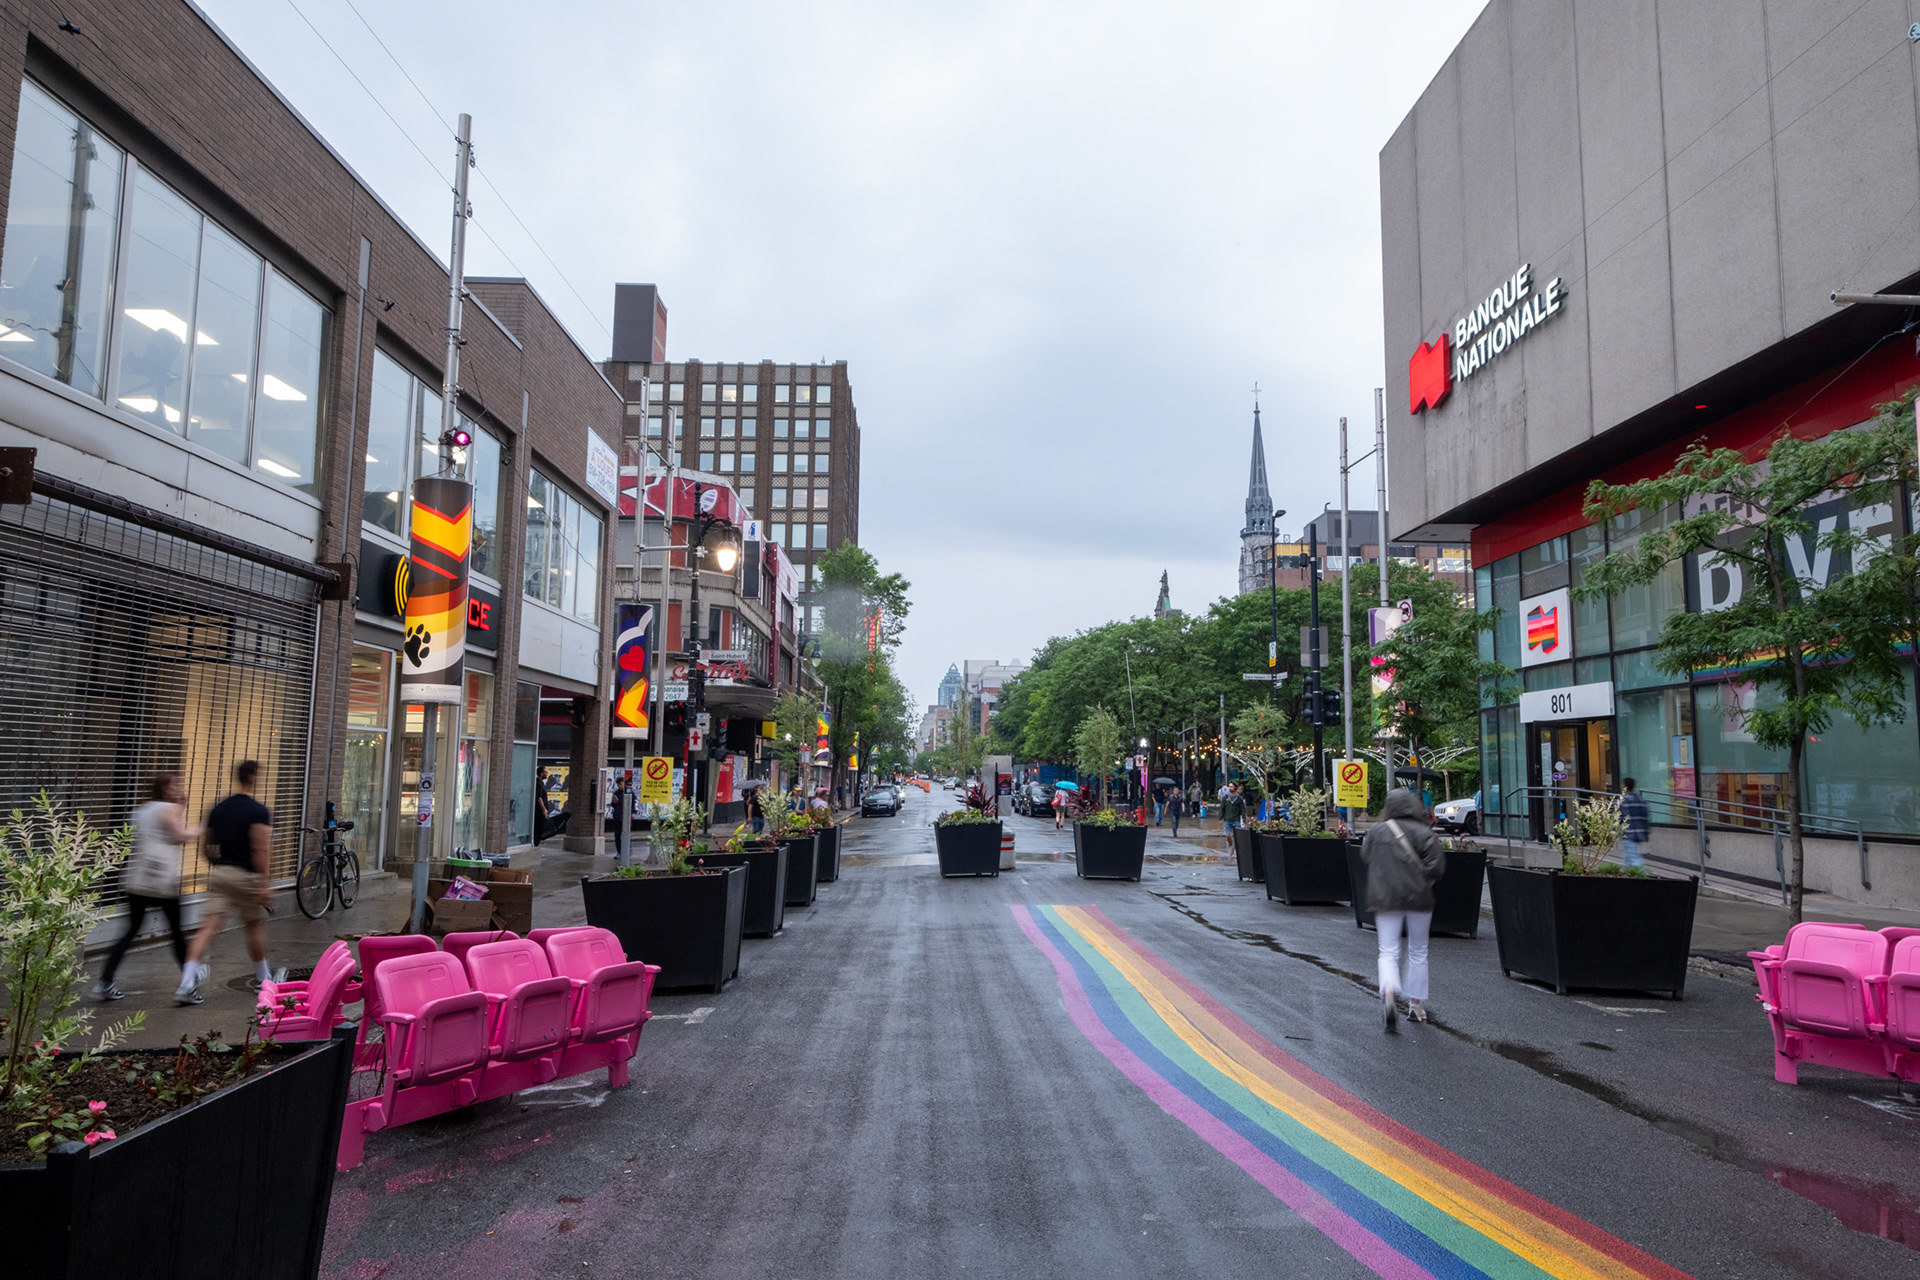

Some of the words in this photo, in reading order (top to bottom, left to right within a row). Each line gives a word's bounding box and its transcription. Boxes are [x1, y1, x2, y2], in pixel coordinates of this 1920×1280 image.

[1455, 263, 1532, 349] BANQUE
[1456, 277, 1562, 383] NATIONALE
[597, 456, 615, 478] LOUER
[710, 651, 746, 659] Saint-Hubert
[1551, 693, 1572, 714] 801
